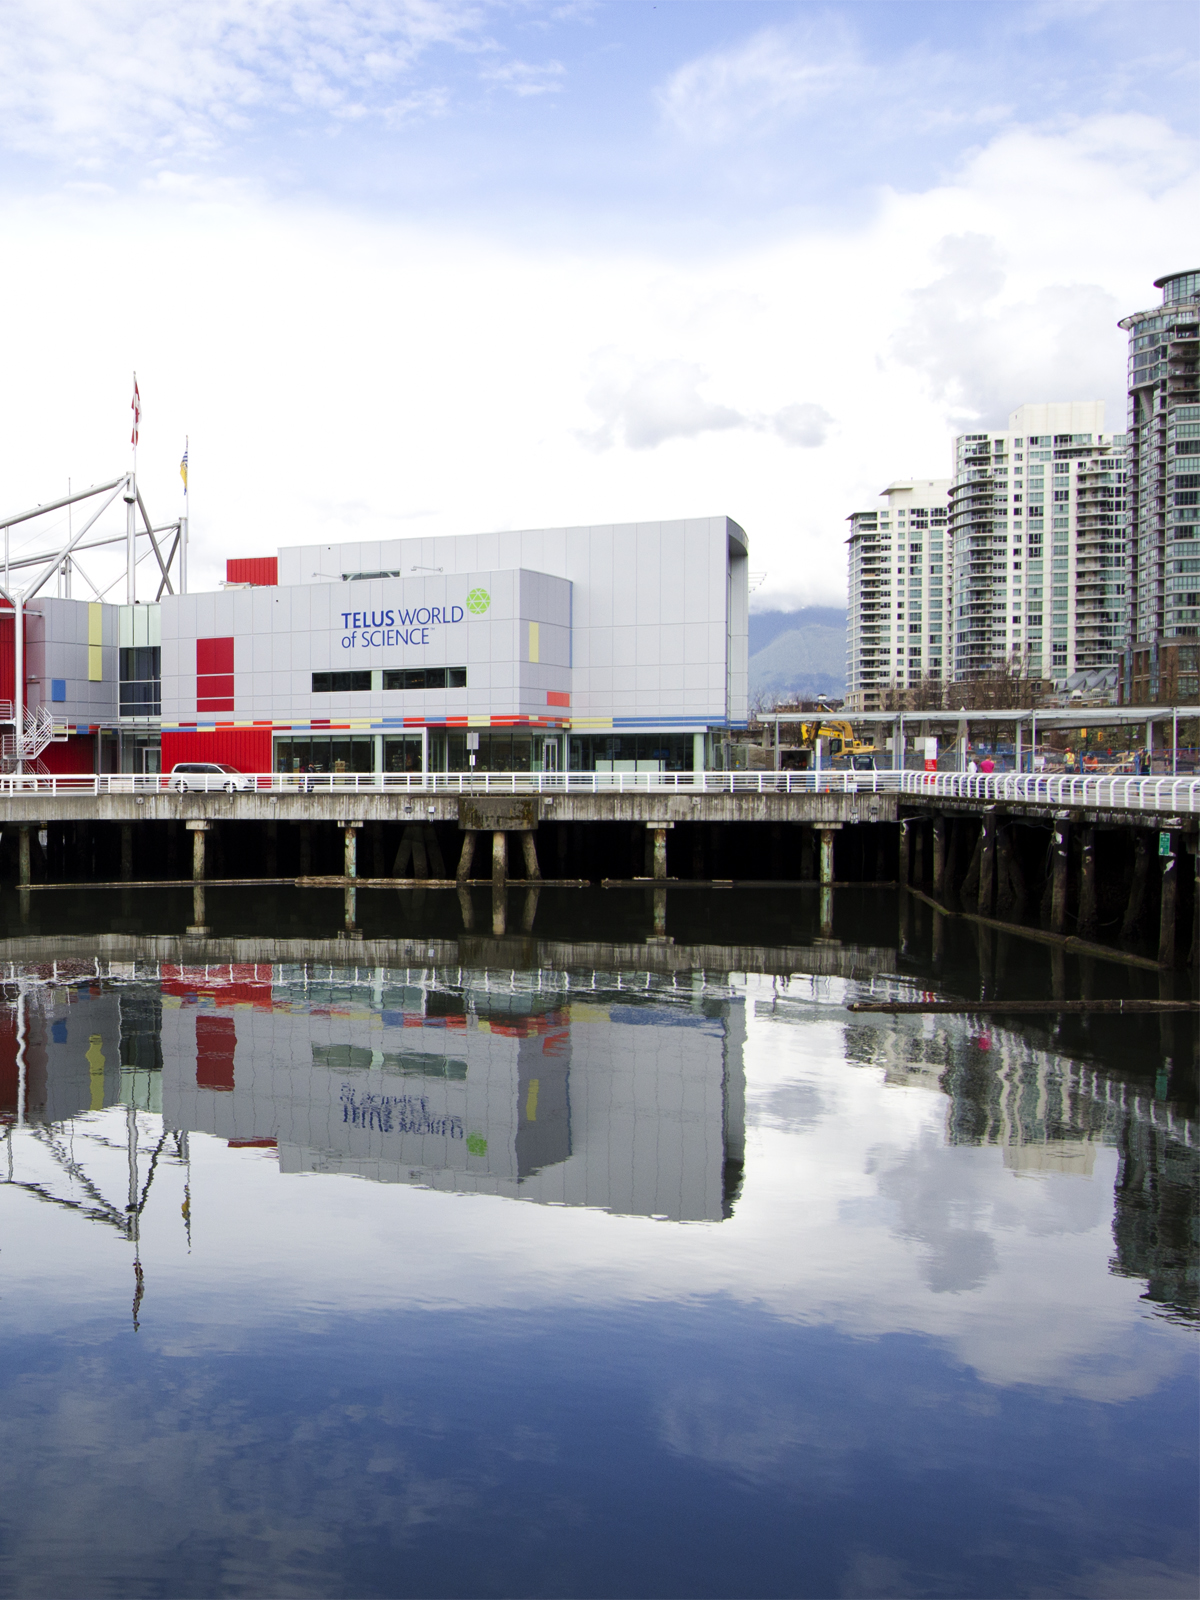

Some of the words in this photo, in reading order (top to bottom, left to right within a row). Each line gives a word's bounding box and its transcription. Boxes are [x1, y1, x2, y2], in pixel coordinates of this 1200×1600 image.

[341, 609, 395, 629] TELUS
[398, 605, 464, 626] WORLD
[341, 630, 357, 649] of
[361, 627, 430, 648] SCIENCE
